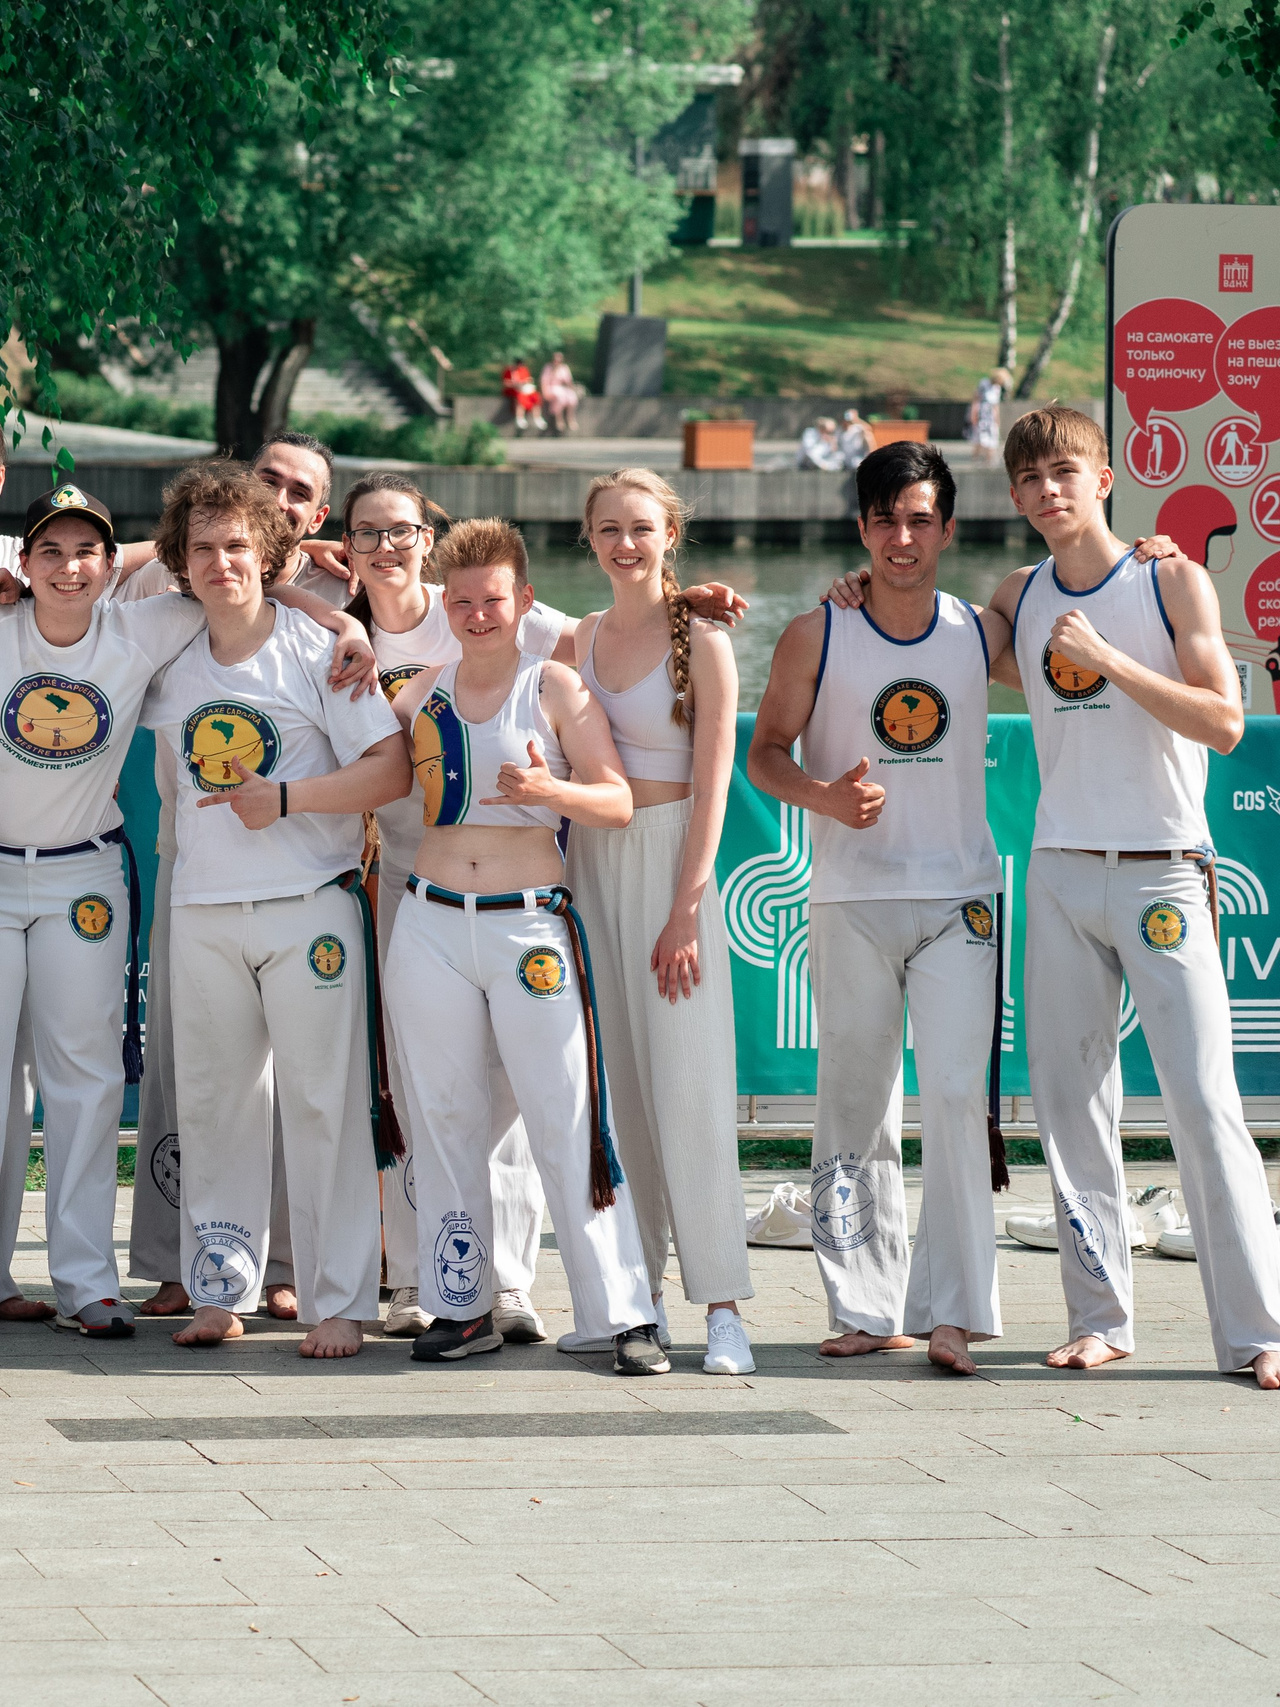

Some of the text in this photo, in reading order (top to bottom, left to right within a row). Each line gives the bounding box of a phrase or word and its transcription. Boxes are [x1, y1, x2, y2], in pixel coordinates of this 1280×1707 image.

[1223, 280, 1248, 288] ВДНХ
[1127, 332, 1213, 343] на самокате
[1228, 340, 1245, 350] не
[1126, 350, 1174, 361] только
[1228, 357, 1244, 367] на
[1126, 368, 1206, 383] в одиночку
[1227, 375, 1261, 389] зону
[15, 678, 100, 705] GRUPO AXÉ CAPOEIRA
[878, 681, 943, 709] GRUPO AXÉ CAPOEIRA
[425, 696, 447, 720] XÉ
[1053, 704, 1080, 713] Professor
[14, 736, 97, 758] MESTRE BARRÃO
[884, 735, 909, 751] MESTRE
[64, 744, 111, 770] PARAFUSO
[878, 757, 914, 765] Professor
[1233, 790, 1265, 811] COS
[210, 1221, 251, 1239] BARRÃO
[442, 1289, 478, 1303] CAPOEIRA
